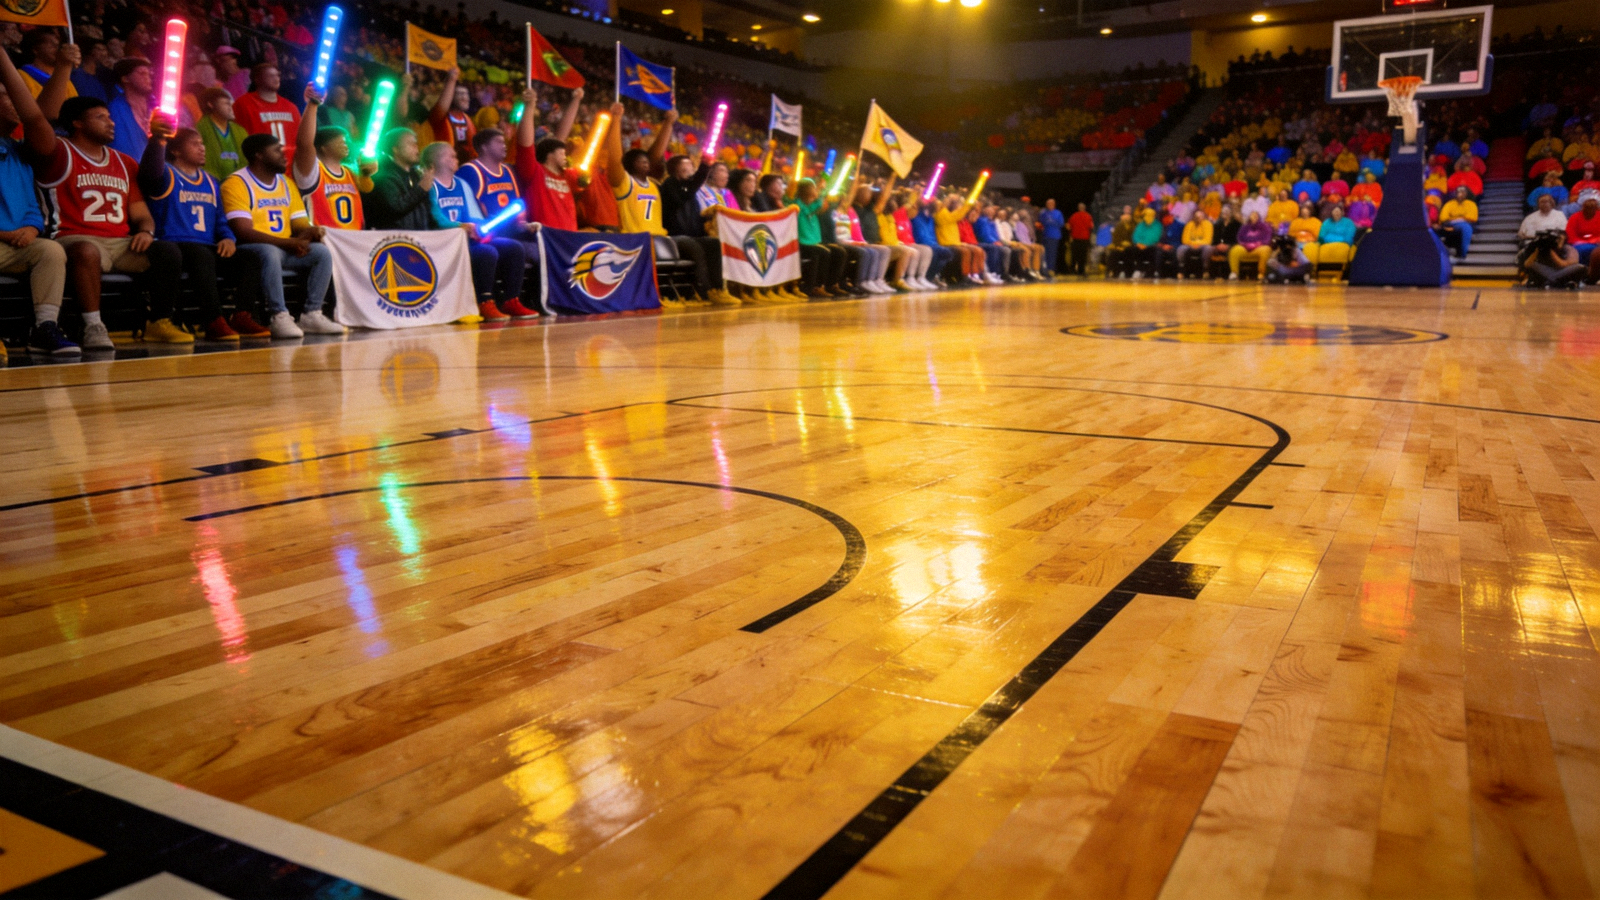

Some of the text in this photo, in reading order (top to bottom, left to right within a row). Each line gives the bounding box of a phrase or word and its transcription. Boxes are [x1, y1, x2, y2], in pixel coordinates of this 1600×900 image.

[82, 189, 124, 224] 23
[335, 195, 353, 223] 0
[268, 210, 284, 233] 5
